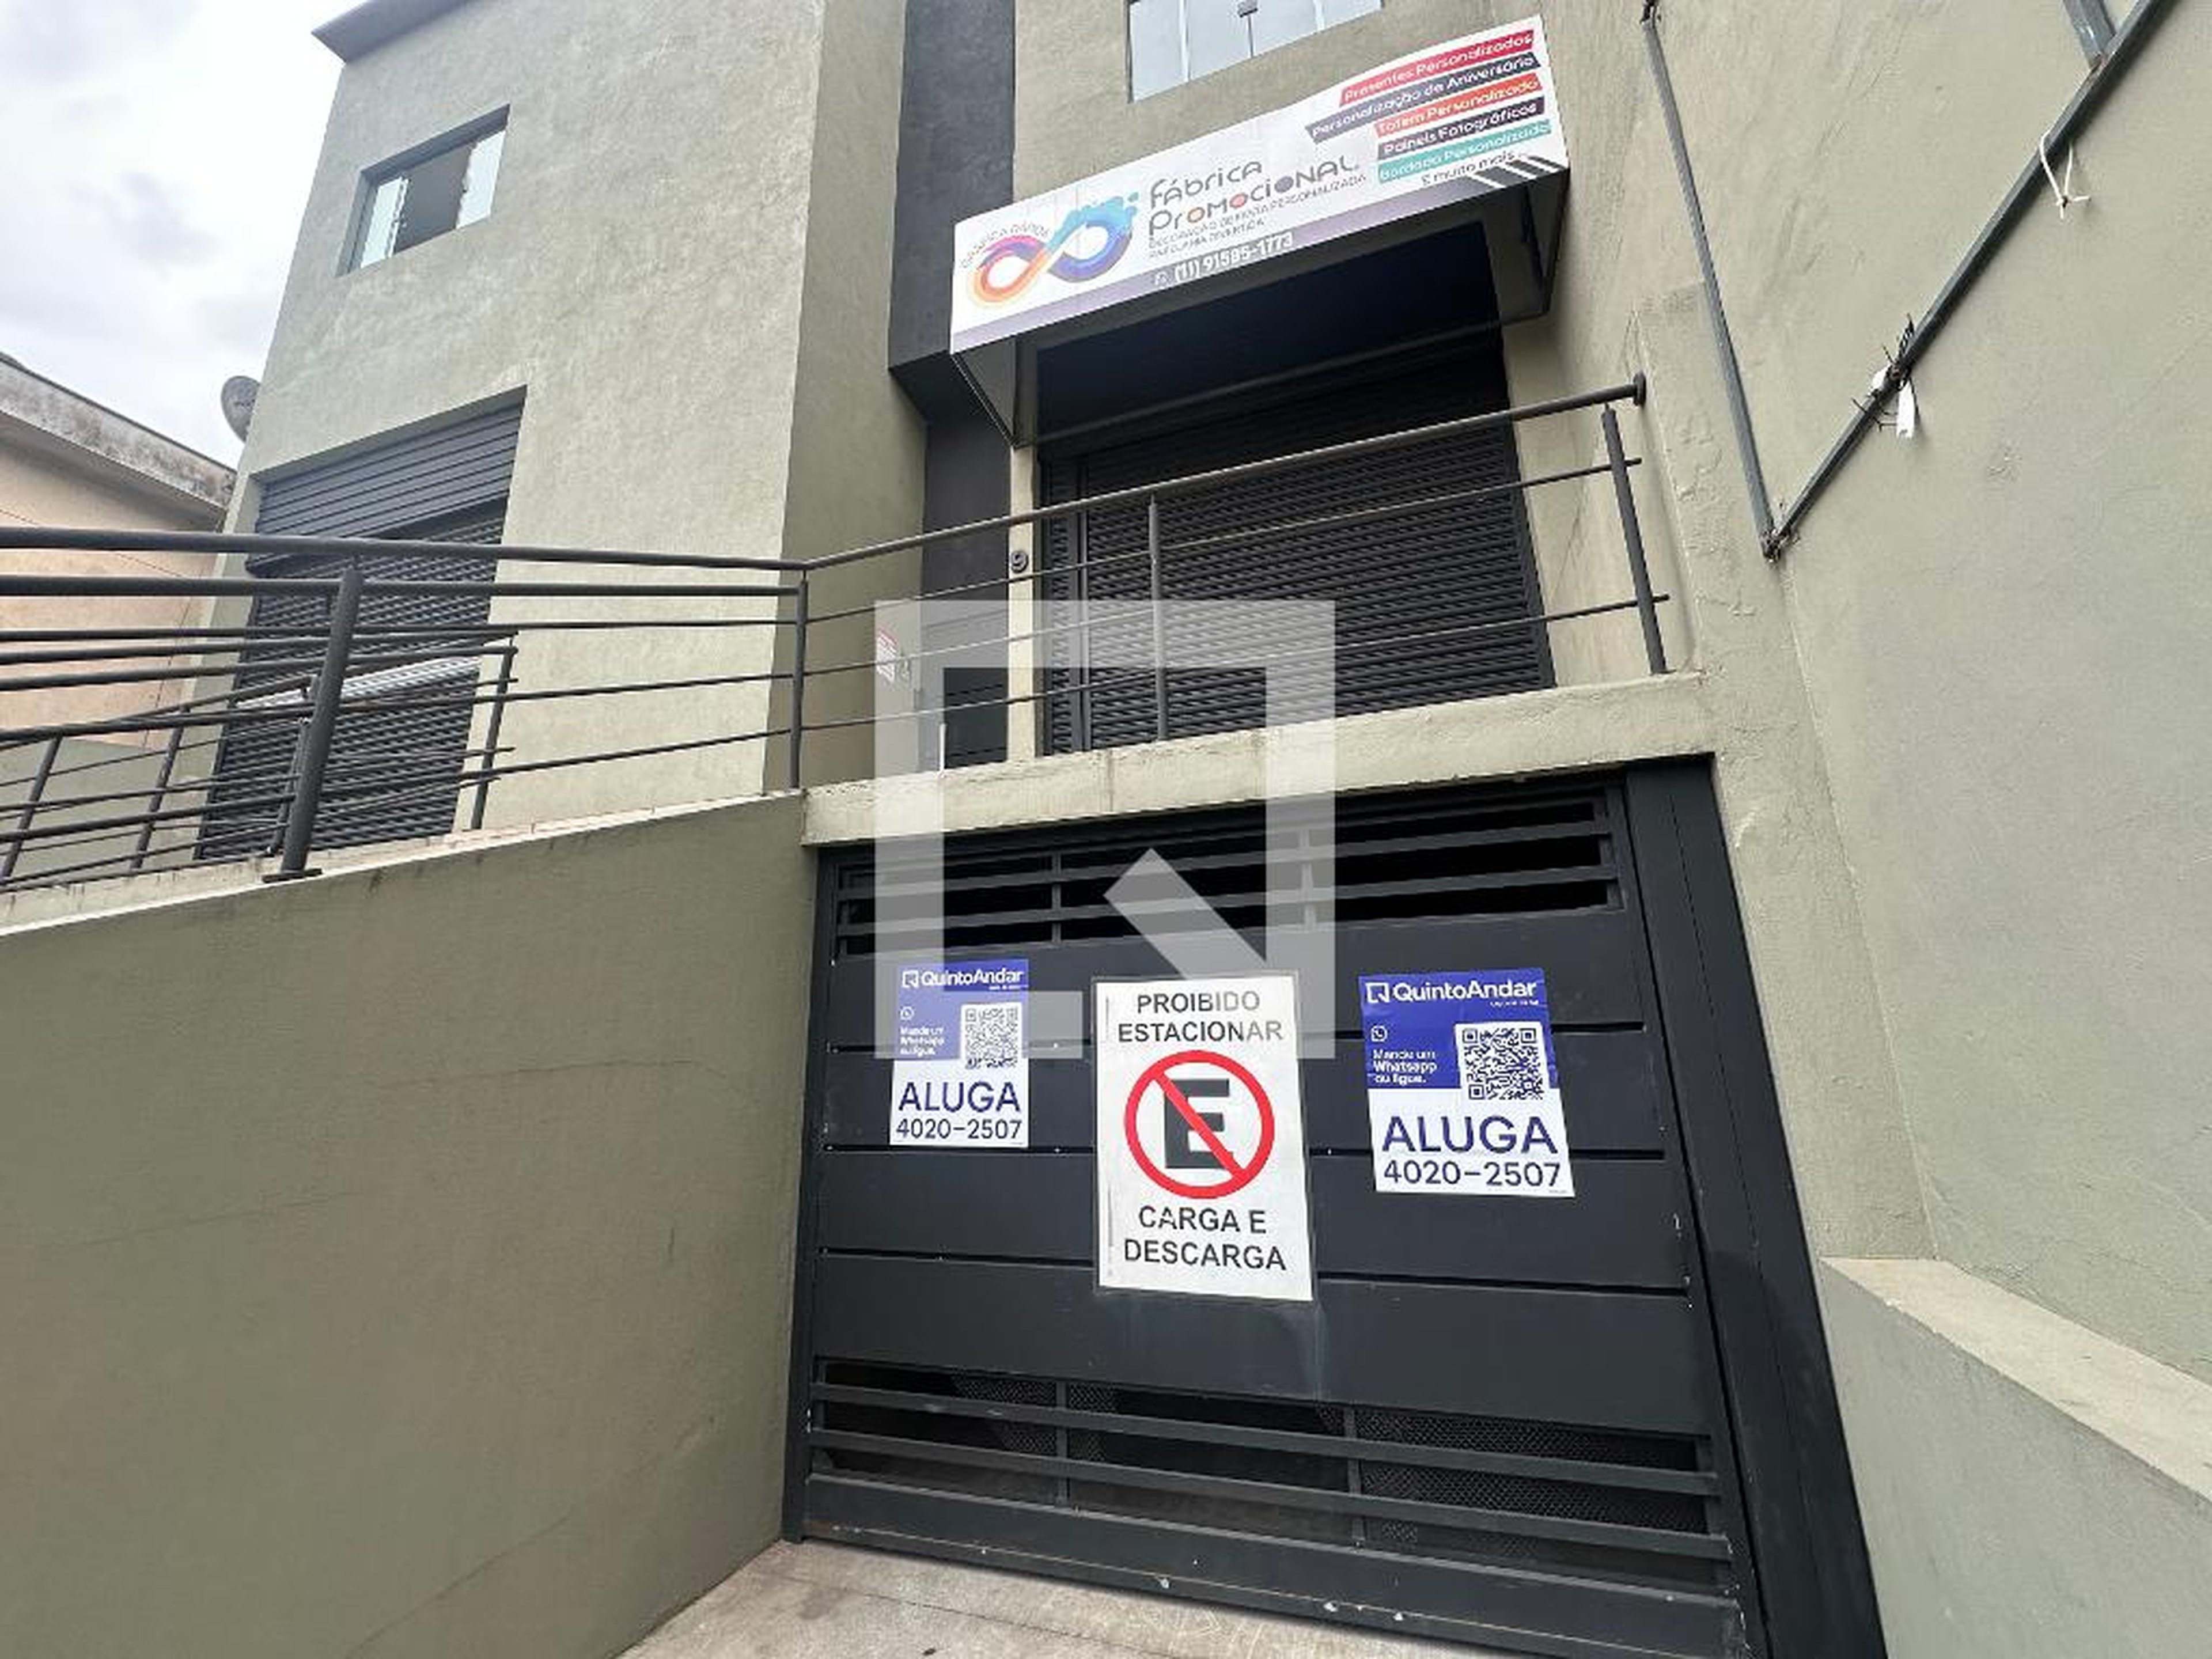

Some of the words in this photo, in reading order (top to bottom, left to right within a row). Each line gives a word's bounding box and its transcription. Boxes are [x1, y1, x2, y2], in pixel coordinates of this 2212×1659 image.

[1344, 67, 1414, 101] Presentes
[1416, 36, 1533, 77] Personalizados
[1312, 88, 1421, 138] Personalização
[1425, 81, 1444, 97] de
[1446, 56, 1535, 90] Aniversário
[1378, 113, 1425, 134] Totem
[1427, 79, 1538, 120] Personalizado
[1438, 103, 1537, 141] Fotográficos
[1444, 123, 1551, 161] Personalizado
[1151, 161, 1262, 209] Fábrica
[922, 968, 1024, 986] QuintoAndar
[1393, 980, 1537, 1002] QuintoAndar
[1137, 990, 1260, 1014] PROIBIDO
[1118, 1021, 1283, 1043] ESTACIONAR
[899, 1082, 1020, 1112] ALUGA
[896, 1119, 1022, 1139] 4020-2507
[1382, 1116, 1558, 1154] ALUGA
[1384, 1160, 1560, 1187] 4020-2507
[1139, 1205, 1240, 1232] CARGA
[1250, 1210, 1267, 1234] E
[1124, 1239, 1286, 1271] DESCARGA
